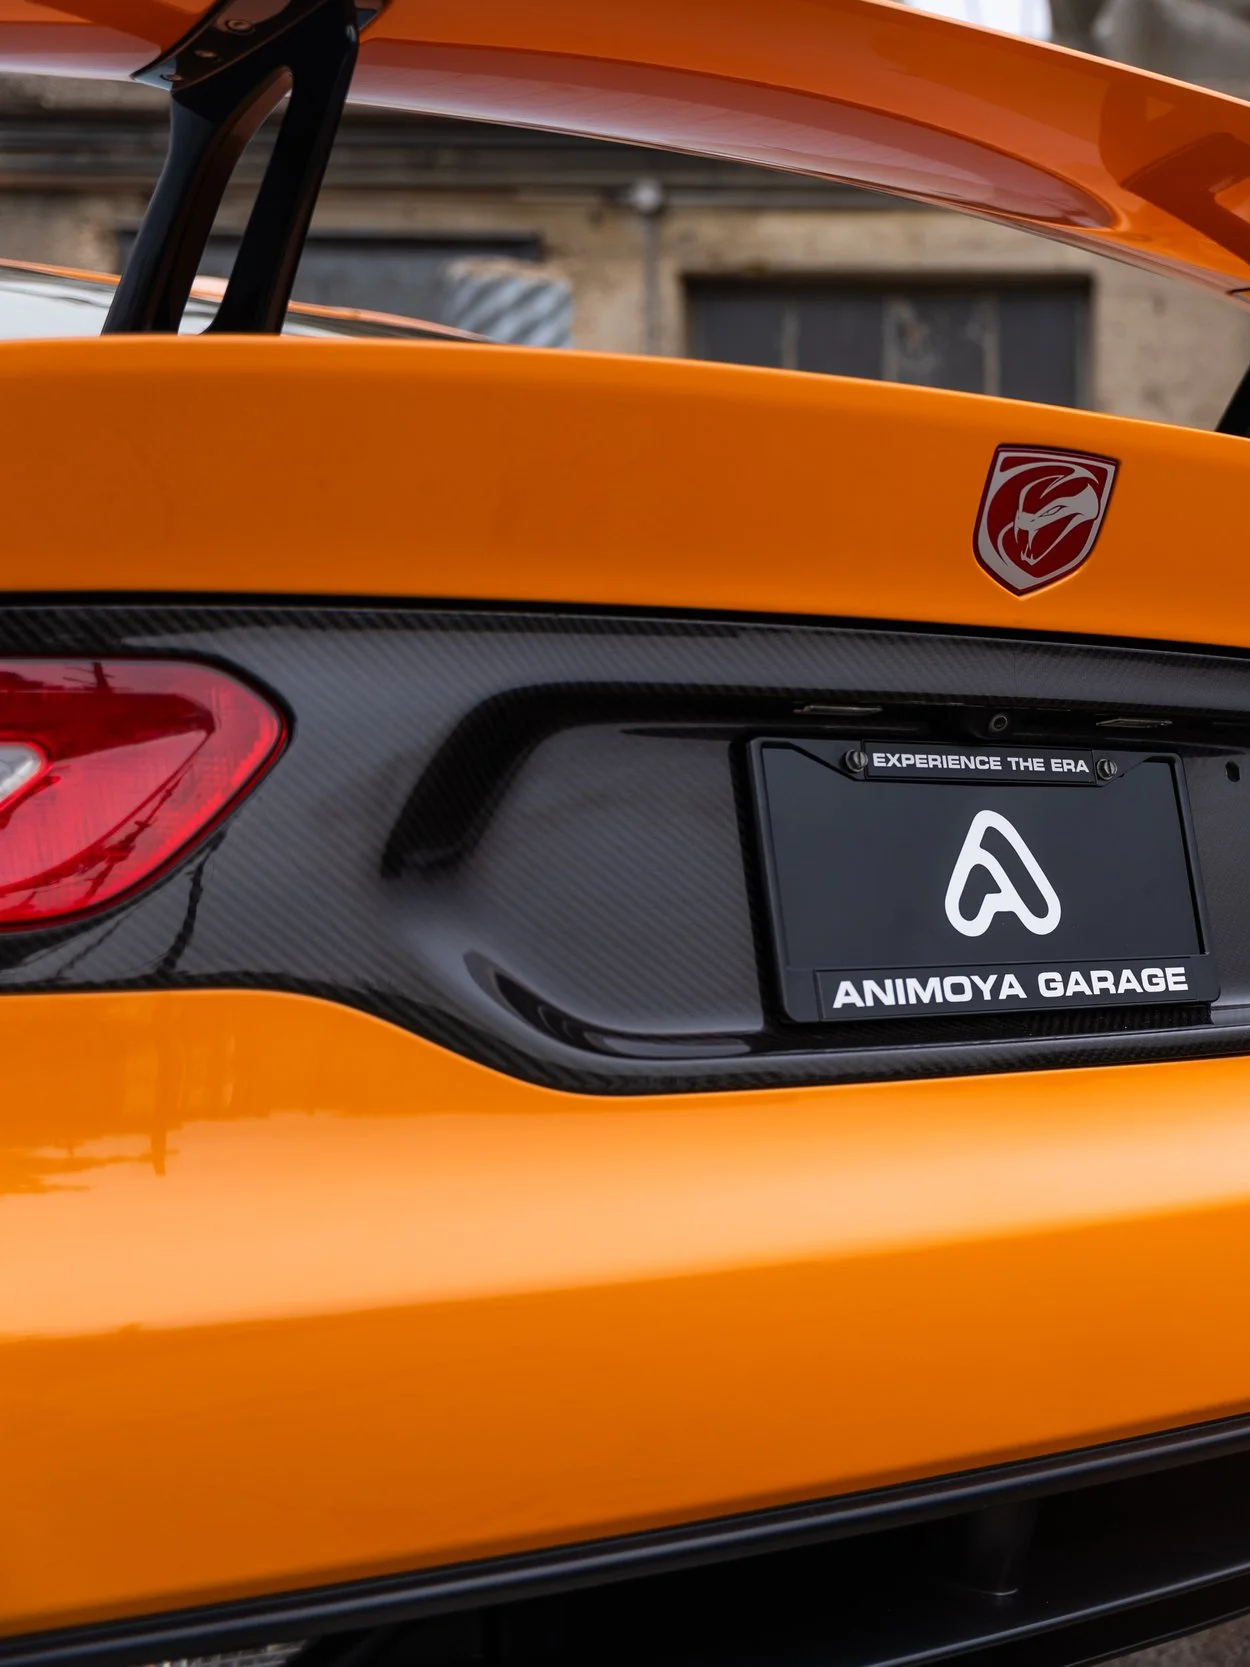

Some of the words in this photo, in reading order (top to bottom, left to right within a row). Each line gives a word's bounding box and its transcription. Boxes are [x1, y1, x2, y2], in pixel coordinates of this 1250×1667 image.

[872, 752, 1002, 770] EXPERIENCE
[1006, 757, 1045, 772] THE
[1050, 758, 1089, 773] ERA
[832, 973, 1027, 1009] ANIMOYA
[1037, 966, 1189, 998] GARAGE
